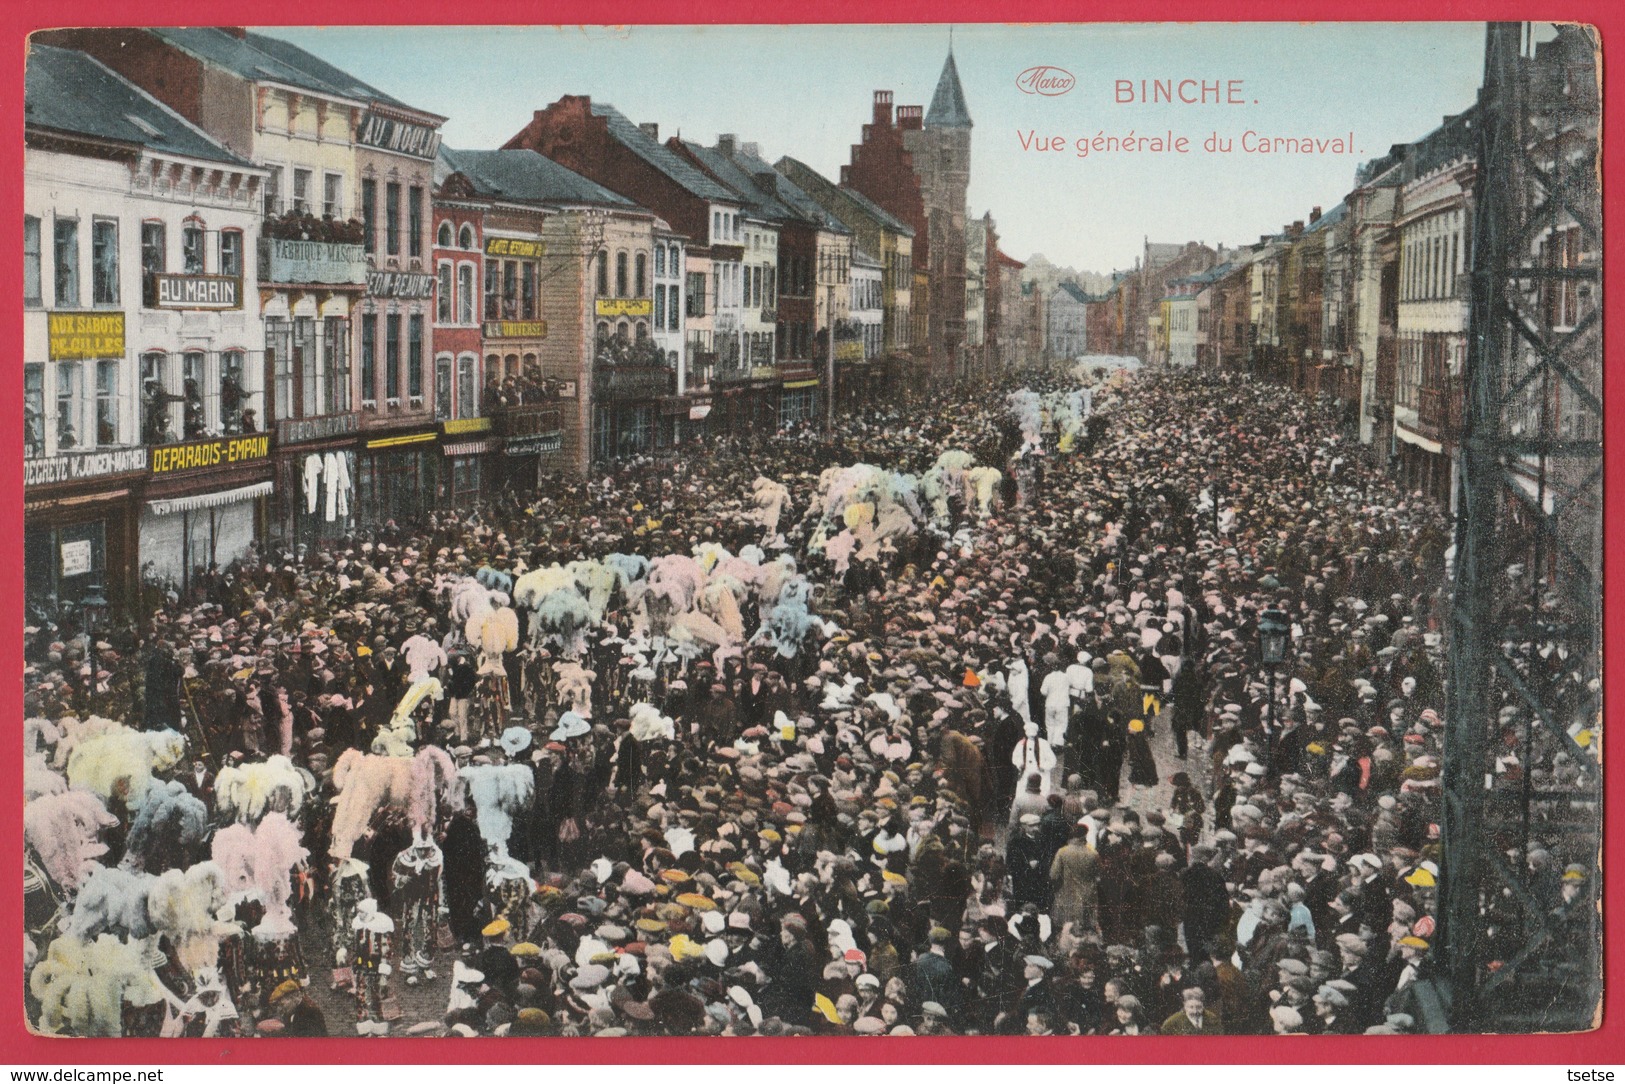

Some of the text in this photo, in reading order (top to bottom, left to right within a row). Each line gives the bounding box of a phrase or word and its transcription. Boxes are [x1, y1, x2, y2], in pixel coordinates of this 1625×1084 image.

[362, 116, 387, 146] AU
[274, 240, 321, 261] FABRIQUE
[159, 279, 235, 302] AU MARIN
[50, 314, 124, 335] AUX SABOTS
[153, 436, 269, 474] DEPARADIS-EMPAIN
